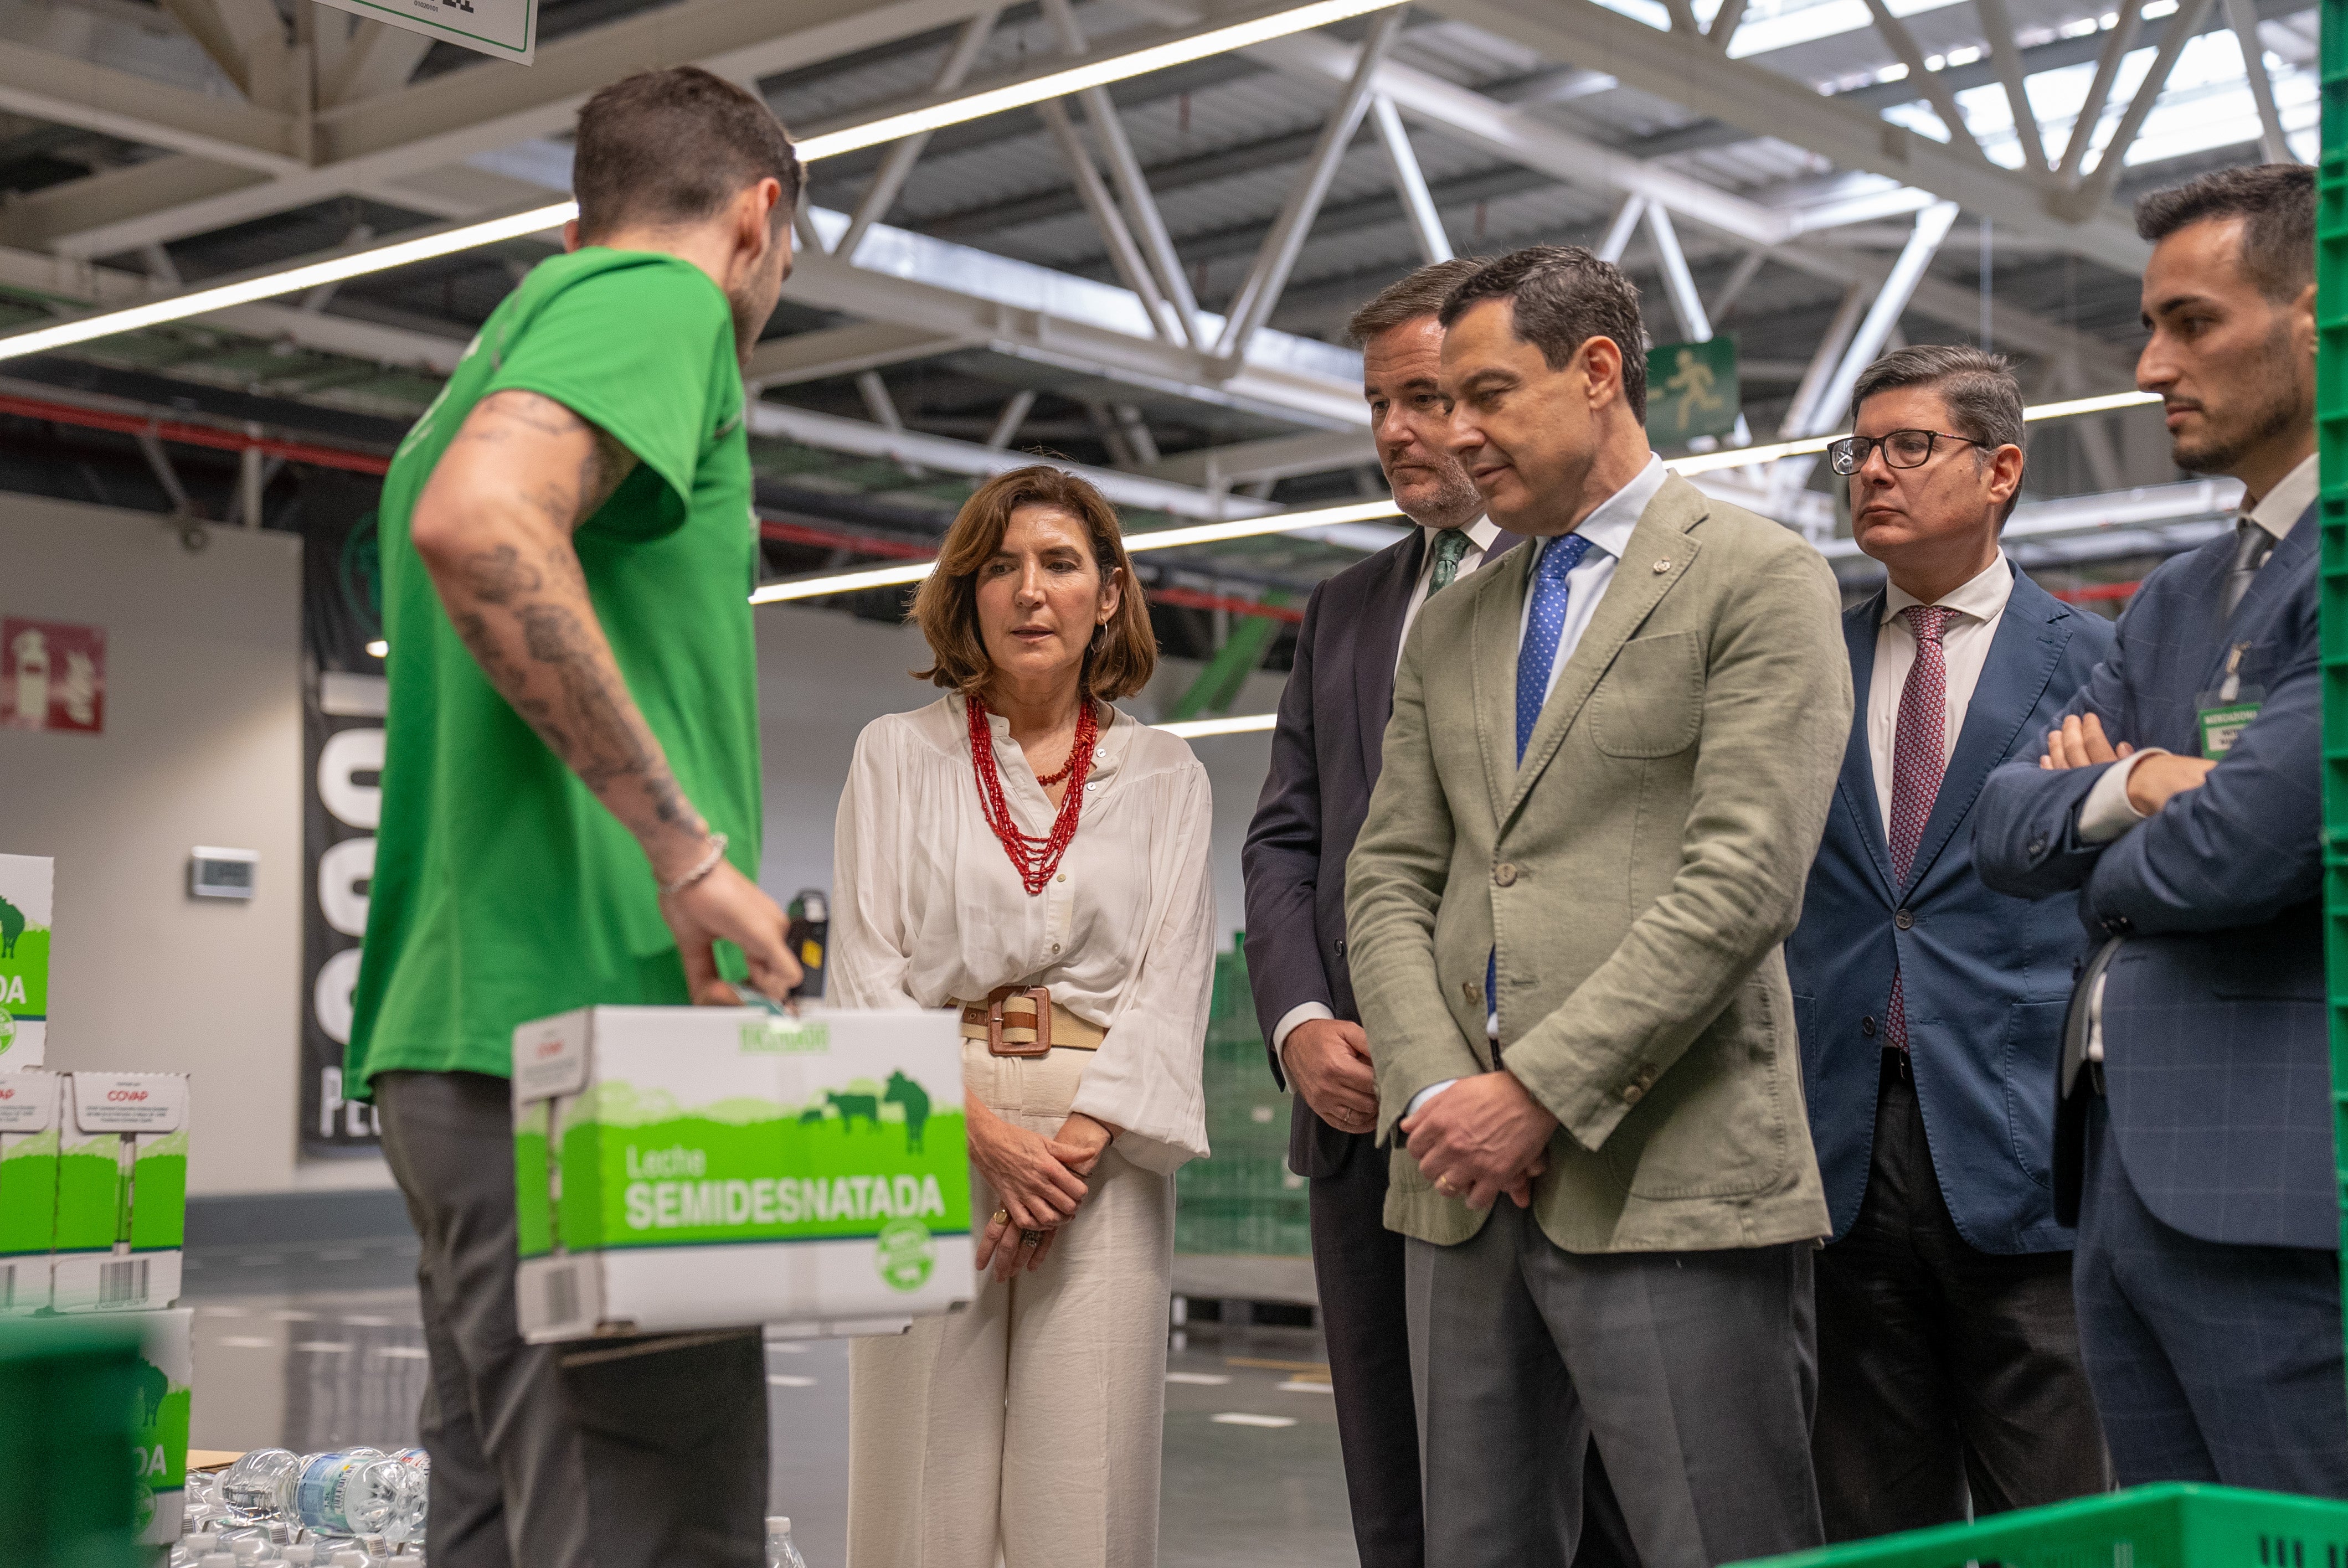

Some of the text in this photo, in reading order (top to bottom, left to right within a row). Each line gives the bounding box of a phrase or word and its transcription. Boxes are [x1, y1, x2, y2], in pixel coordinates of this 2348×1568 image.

[414, 1, 438, 12] 01020101
[626, 1145, 706, 1178] Leche
[625, 1174, 945, 1230] SEMIDESNATADA
